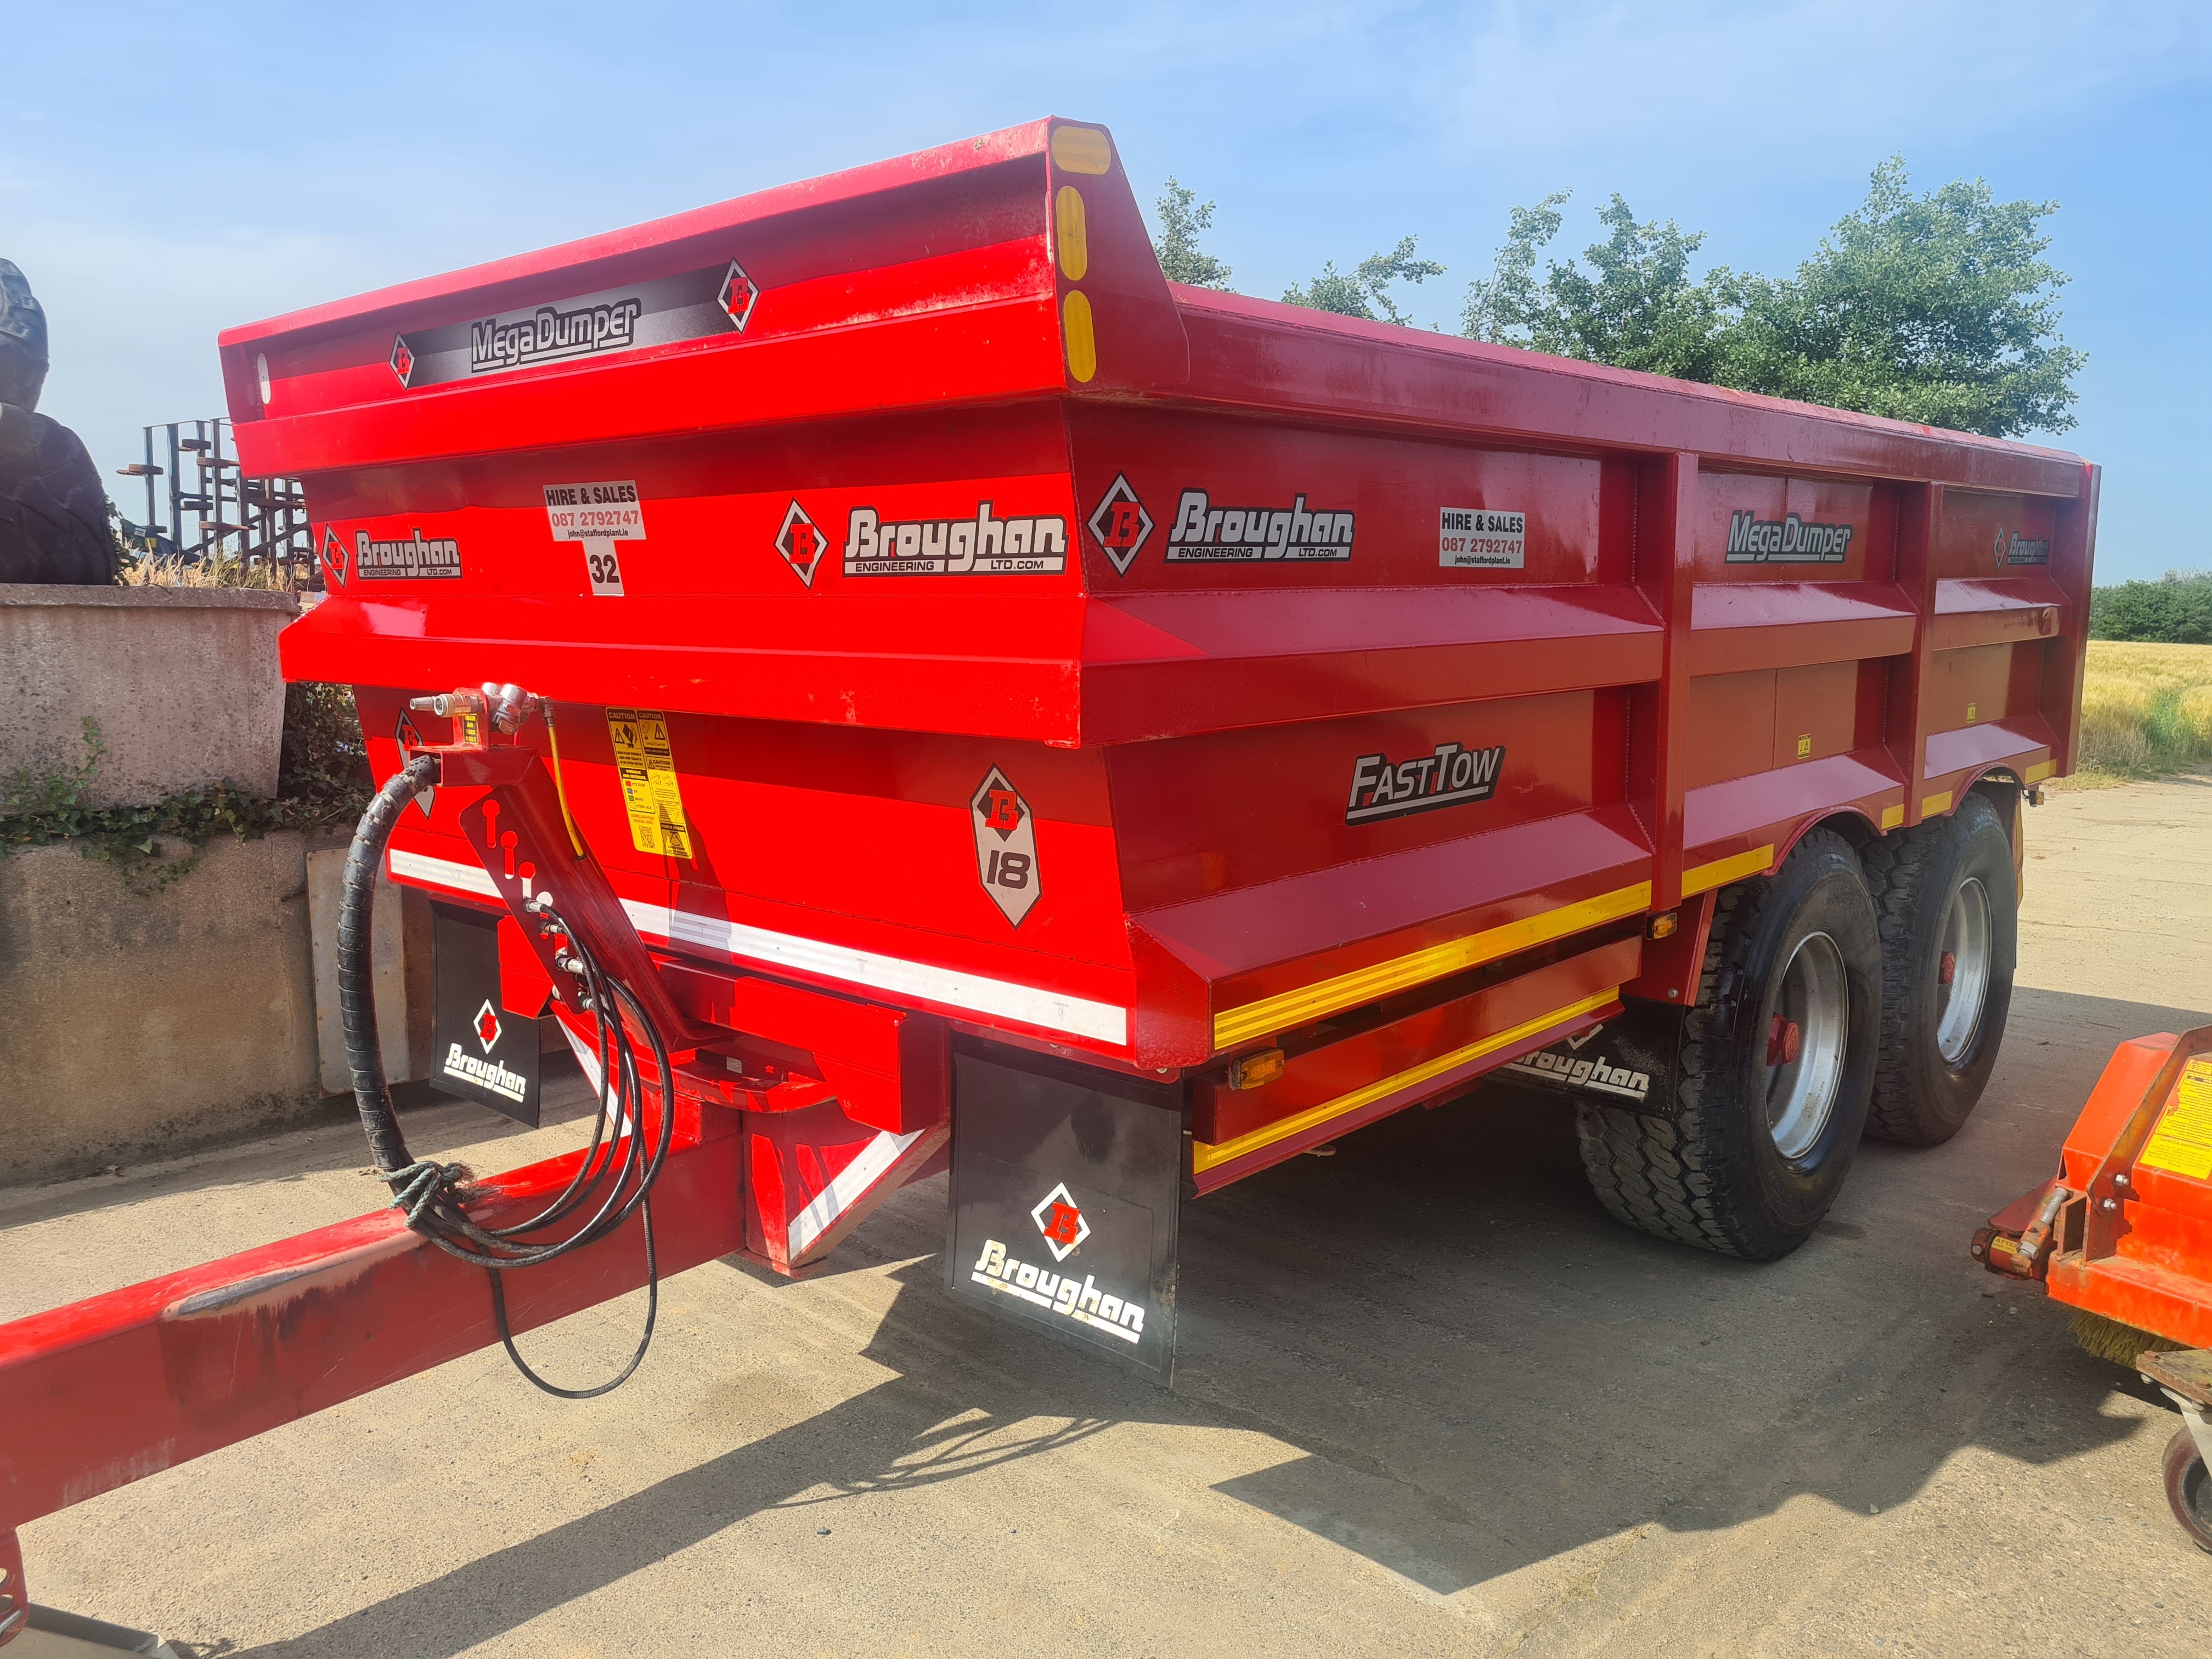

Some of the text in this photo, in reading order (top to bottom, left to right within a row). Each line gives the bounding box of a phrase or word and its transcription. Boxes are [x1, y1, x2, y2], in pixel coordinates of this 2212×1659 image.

[472, 303, 637, 365] MegaDumper
[546, 485, 636, 506] HIRE & SALES
[551, 510, 639, 527] 087 2792747
[567, 528, 629, 539] john@staffordplant.ie
[845, 504, 1065, 572] Broughan
[1103, 501, 1141, 548] B
[1170, 492, 1353, 558] Broughan
[1442, 512, 1523, 533] HIRE & SALES
[1728, 515, 1851, 561] MegaDumper
[357, 530, 460, 577] Broughan
[789, 523, 815, 564] B
[1177, 548, 1338, 558] ENGINEERING LTD.COM
[1442, 537, 1522, 554] 087 2792747
[1454, 555, 1510, 566] john@staffordplant.ie
[589, 554, 620, 584] 32
[855, 559, 1045, 572] ENGINEERING LTD.COM
[608, 712, 635, 720] CAUTION
[985, 789, 1018, 831] B
[986, 850, 1031, 889] 18
[445, 1042, 527, 1095] Broughan
[1511, 1050, 1650, 1092] roughan
[1043, 1201, 1080, 1245] B
[974, 1238, 1146, 1333] Broughan
